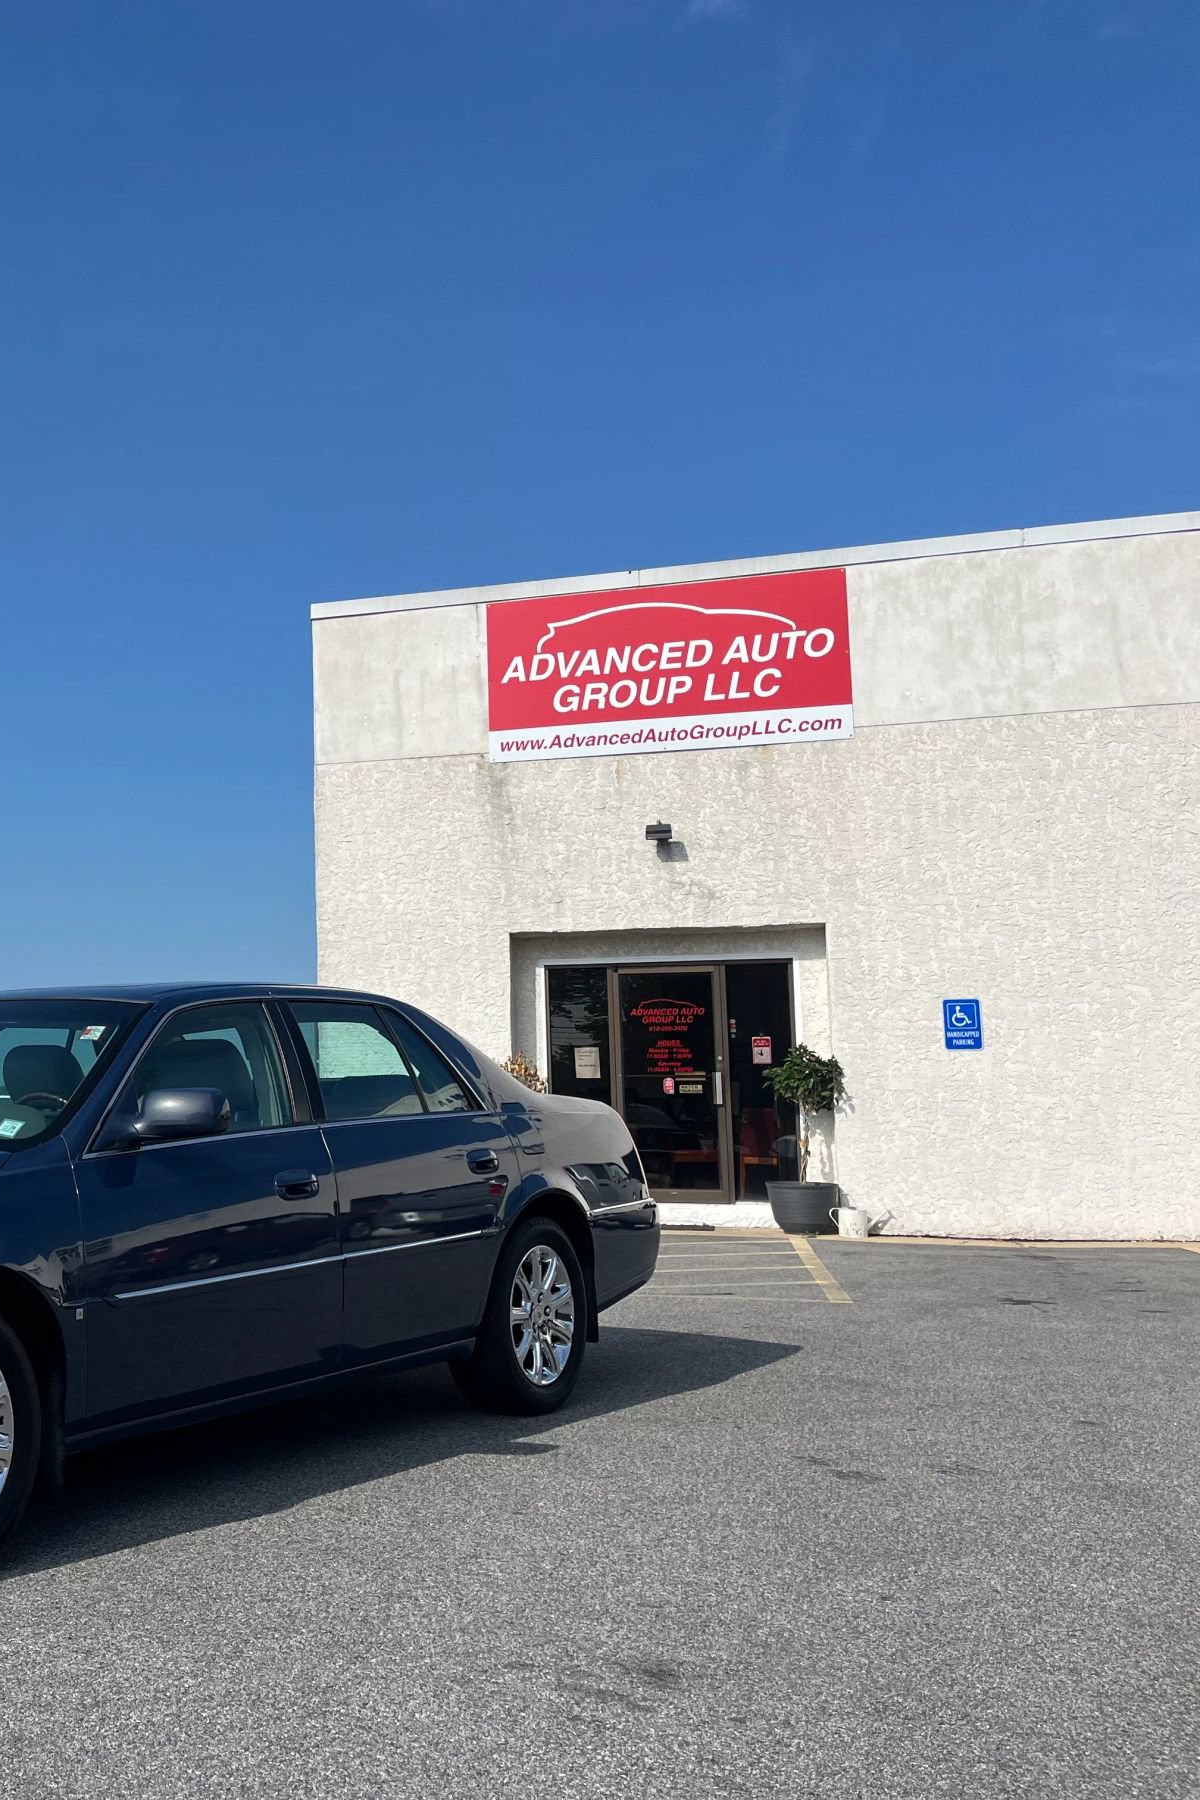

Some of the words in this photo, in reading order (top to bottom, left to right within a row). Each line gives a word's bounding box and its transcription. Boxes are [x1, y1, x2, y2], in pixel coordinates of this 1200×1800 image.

[500, 638, 714, 684] ADVANCED
[720, 627, 835, 665] AUTO
[552, 675, 693, 713] GROUP
[703, 667, 783, 702] LLC
[500, 717, 843, 752] www.AdvancedAutoGroupLLC.com
[630, 1008, 679, 1016] ADVANCED
[680, 1007, 705, 1015] AUTO
[642, 1016, 674, 1024] GROUP
[952, 1038, 975, 1046] PARKING
